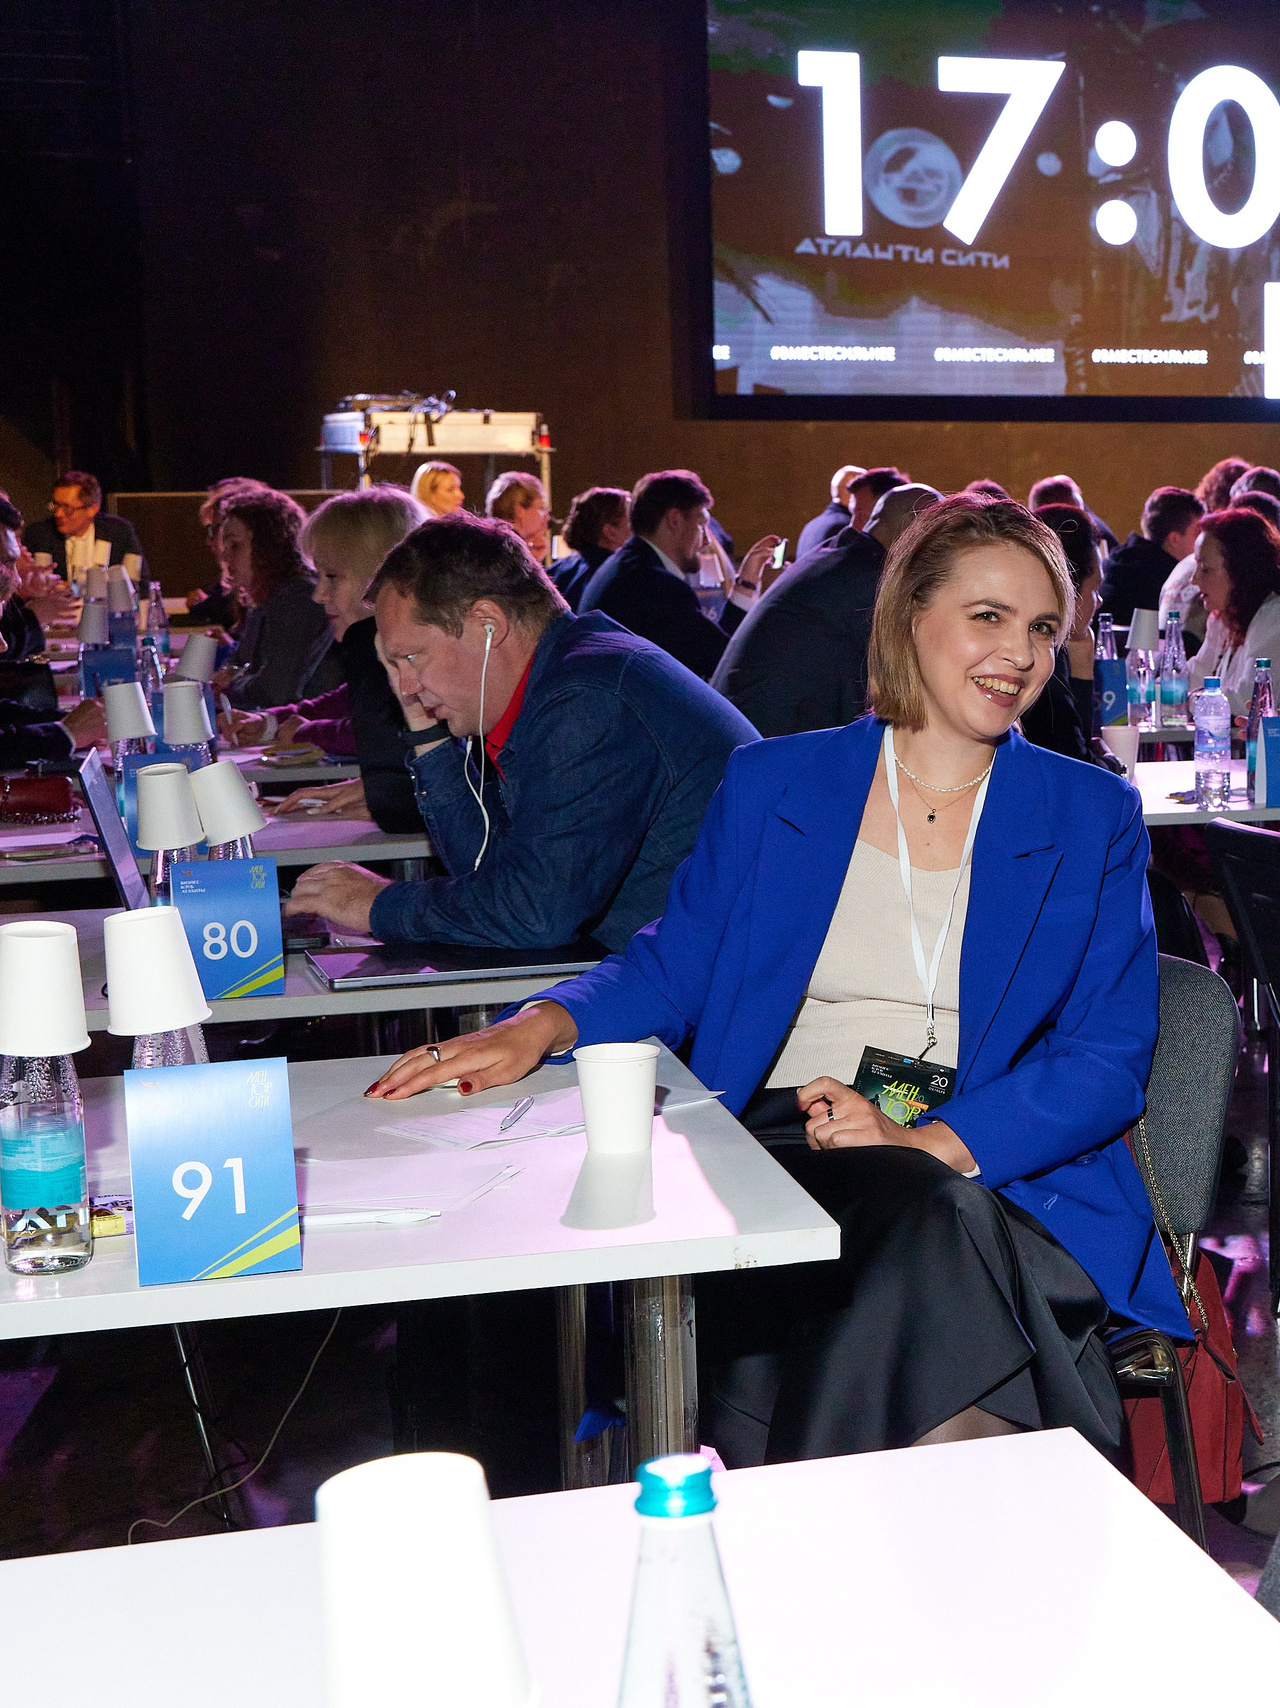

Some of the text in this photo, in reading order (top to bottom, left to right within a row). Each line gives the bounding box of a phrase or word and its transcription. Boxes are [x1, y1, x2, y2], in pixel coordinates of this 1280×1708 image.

[941, 248, 1010, 270] СИТИ
[202, 919, 259, 961] 80
[247, 1070, 267, 1083] МЕН
[930, 1074, 949, 1088] 20
[251, 1082, 273, 1096] ТОР
[881, 1080, 920, 1102] МЕН
[248, 1095, 270, 1109] СИТИ
[884, 1097, 922, 1123] ТОР
[171, 1157, 246, 1222] 91
